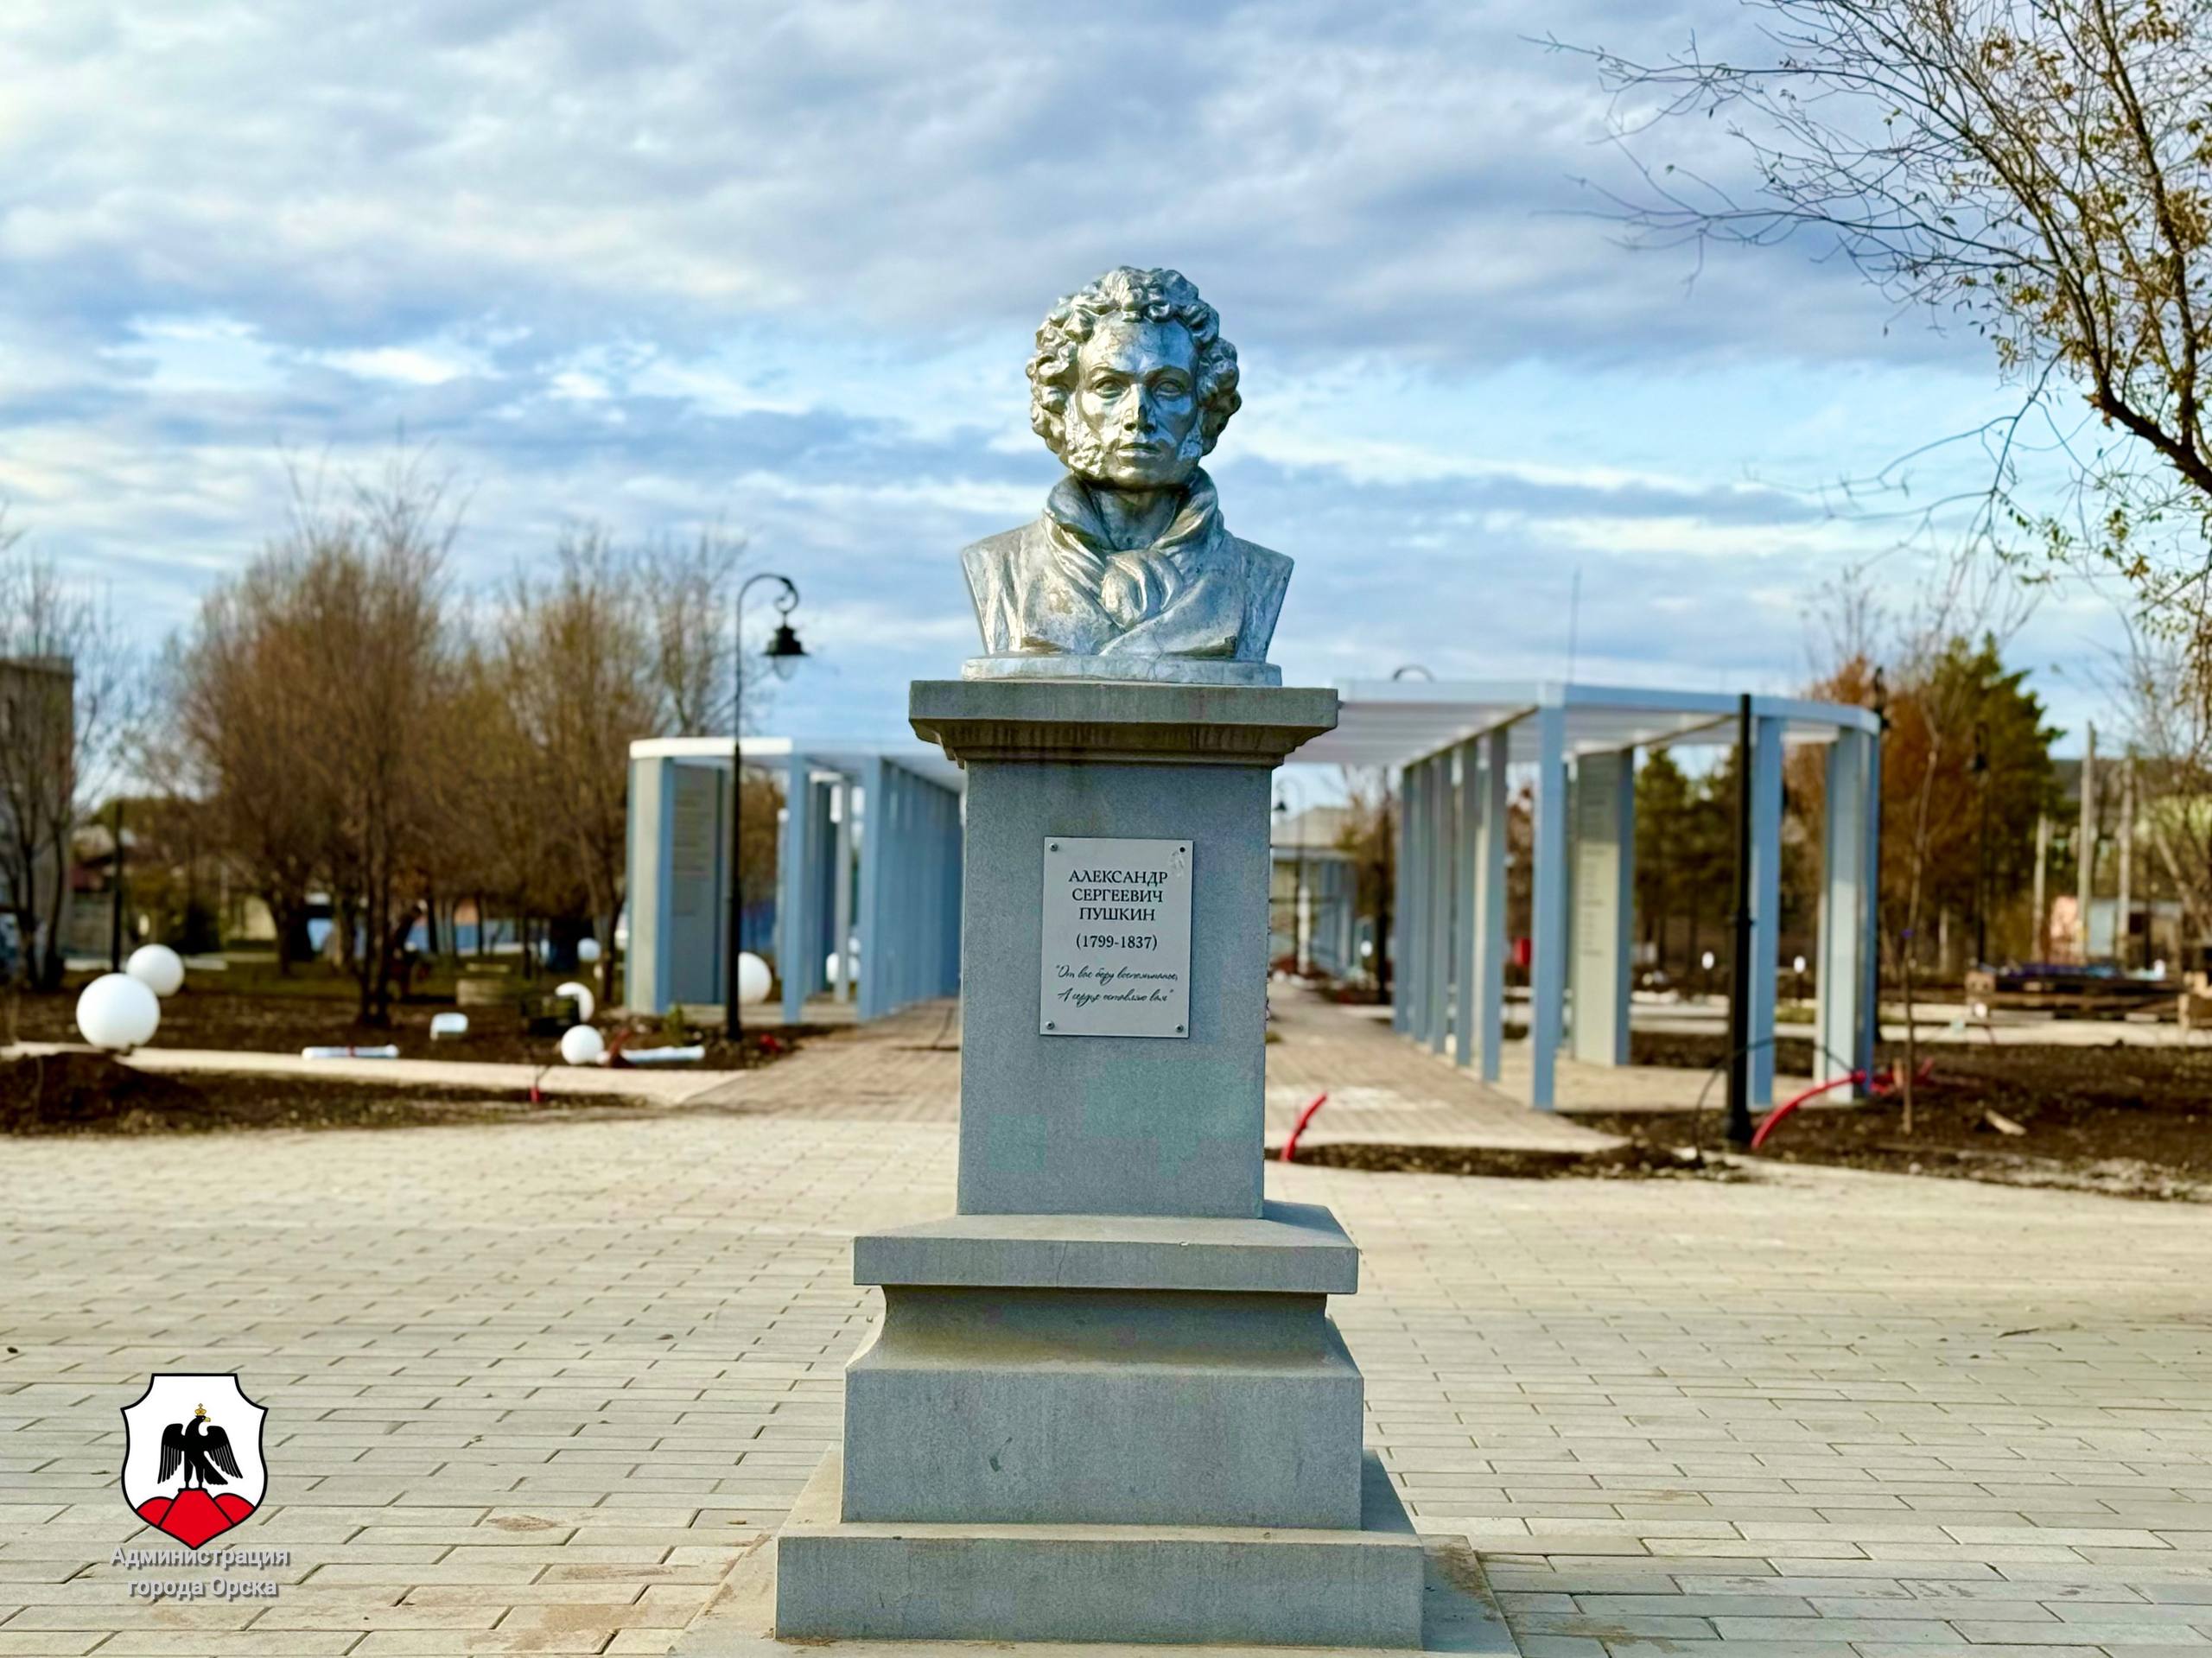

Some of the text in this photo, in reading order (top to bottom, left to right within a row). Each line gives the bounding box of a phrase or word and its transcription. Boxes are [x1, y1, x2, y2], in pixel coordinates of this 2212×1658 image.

[1068, 870, 1168, 886] АЛЕКСАНДР
[1071, 888, 1163, 903] СЕРГЕЕВИЧ
[1079, 907, 1155, 921] ПУШКИН
[1076, 934, 1158, 951] (1799-1837)
[1077, 965, 1093, 979] вас
[1057, 988, 1073, 1002] А
